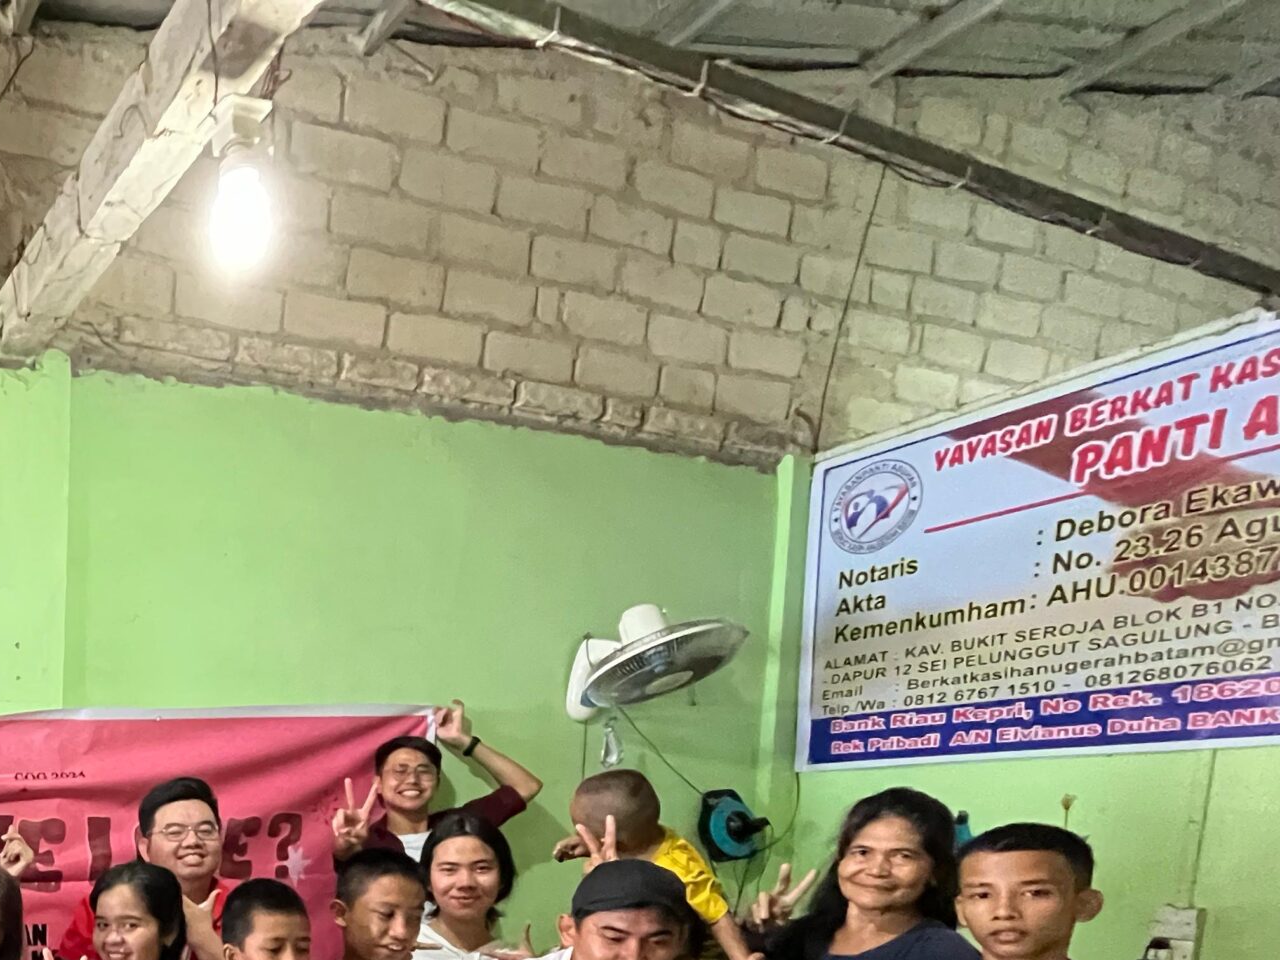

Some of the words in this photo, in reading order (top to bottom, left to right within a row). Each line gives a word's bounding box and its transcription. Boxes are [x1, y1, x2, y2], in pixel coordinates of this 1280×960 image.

[935, 417, 1054, 472] YAYASAN
[1068, 373, 1200, 432] BERKAT
[1209, 347, 1280, 392] KAS
[1074, 408, 1227, 483] PANTI
[1233, 395, 1278, 440] A
[835, 595, 886, 617] Akta
[1052, 551, 1101, 574] No.
[1113, 525, 1203, 563] 23.26
[838, 557, 918, 589] Notaris
[1055, 502, 1171, 542] Debora
[824, 651, 888, 671] ALAMAT
[905, 643, 943, 658] KAV.
[951, 633, 1007, 652] BUKIT
[1015, 618, 1105, 643] SEROJA
[1113, 607, 1182, 629] BLOK
[1192, 602, 1223, 618] B1
[895, 664, 912, 677] 12
[918, 659, 946, 673] SEI
[953, 641, 1080, 669] PELUNGGUT
[1087, 620, 1233, 652] SAGULUNG
[822, 686, 863, 701] Email
[831, 717, 886, 734] Bank
[891, 712, 946, 728] Riau
[953, 702, 1033, 723] Kepri,
[1041, 698, 1081, 715] No
[1089, 690, 1162, 711] Rek.
[903, 692, 947, 707] 0812
[954, 686, 999, 701] 6767
[1008, 680, 1055, 696] 1510
[1085, 656, 1273, 689] 081268076062
[831, 741, 864, 755] Rek
[868, 735, 940, 751] Pribadi
[949, 729, 992, 746] A/N
[996, 723, 1102, 743] Elvianus
[1107, 716, 1181, 735] Duha
[1187, 706, 1280, 730] BANK
